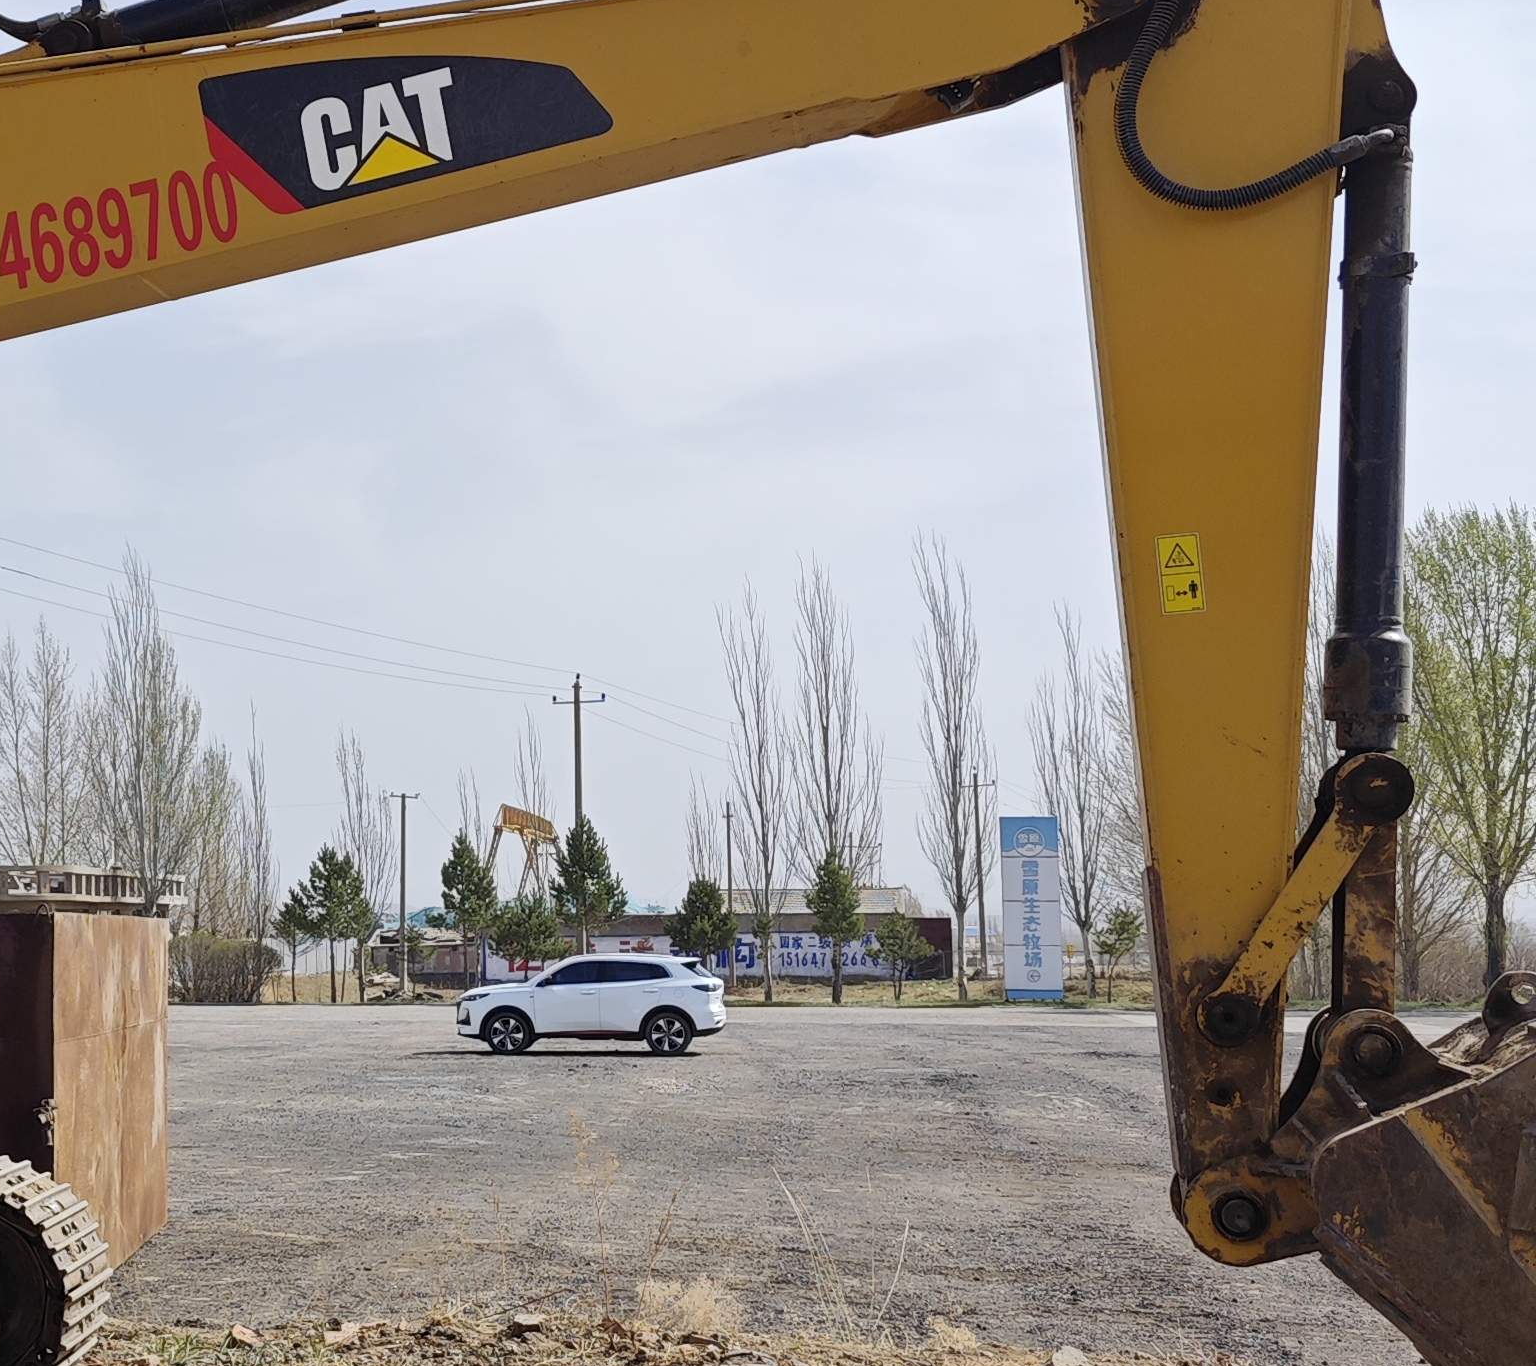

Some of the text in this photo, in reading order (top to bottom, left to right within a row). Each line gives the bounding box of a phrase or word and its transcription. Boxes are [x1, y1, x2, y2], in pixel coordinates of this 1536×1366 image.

[300, 66, 454, 191] CAT
[1021, 860, 1043, 968] 雪原生态牧场
